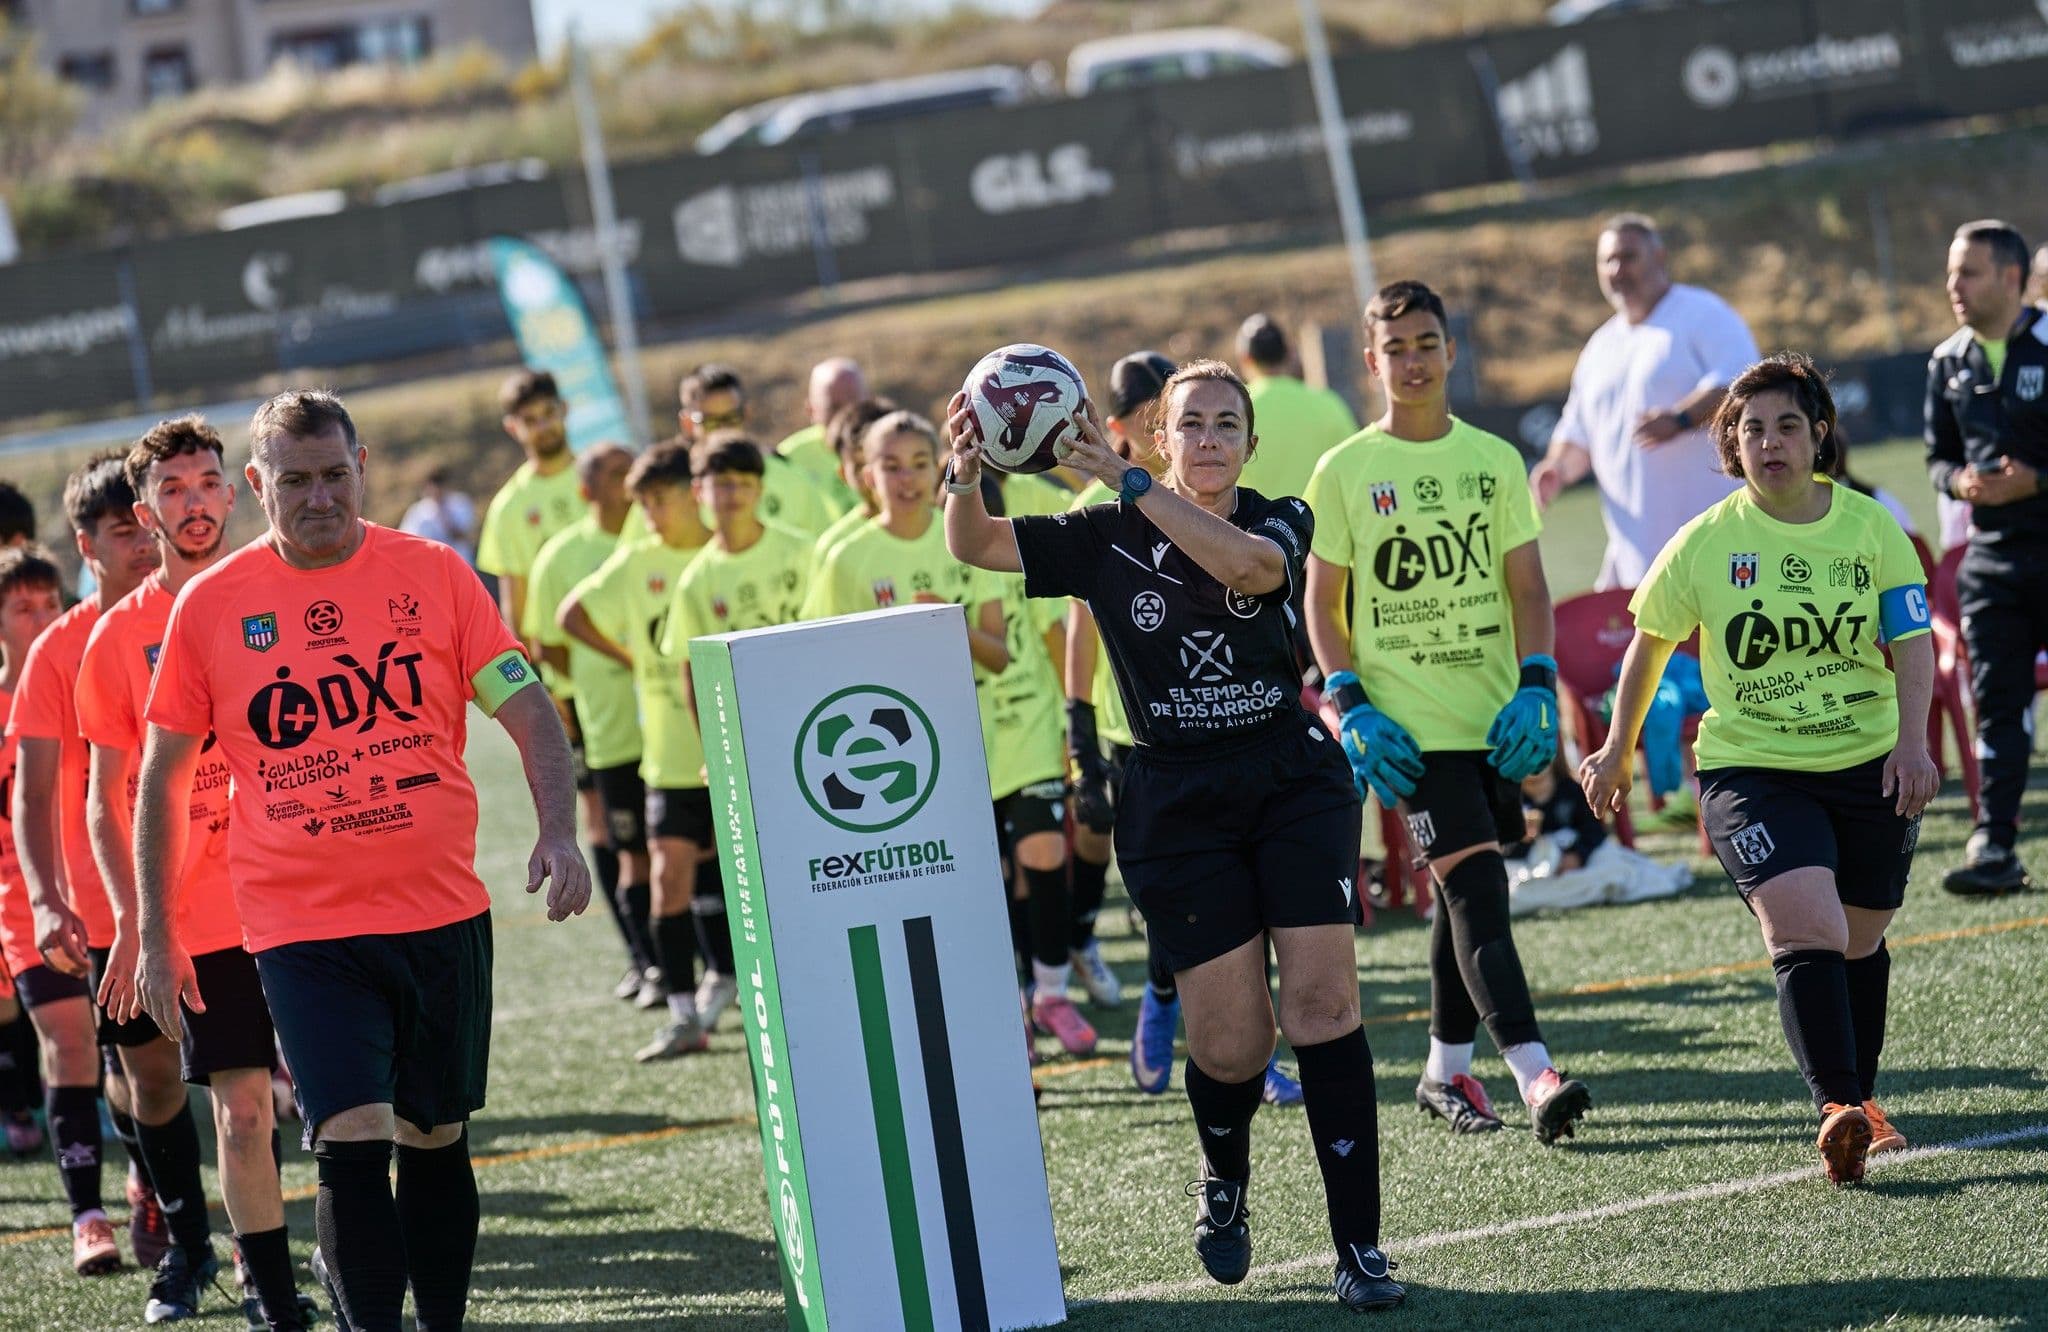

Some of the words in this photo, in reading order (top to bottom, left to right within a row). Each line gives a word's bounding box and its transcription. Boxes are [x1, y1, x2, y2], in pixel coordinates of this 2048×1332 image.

[1905, 588, 1927, 623] C
[1168, 688, 1192, 703] EL
[1191, 680, 1264, 702] TEMPLO
[1149, 702, 1173, 718] DE
[1176, 703, 1209, 718] LOS
[331, 810, 413, 833] EXTREMADURA
[358, 806, 393, 820] RURAL
[393, 802, 407, 812] DE
[811, 876, 862, 893] FEDERACIÓN
[864, 868, 911, 886] EXTREMEÑA
[912, 867, 923, 877] DE
[925, 863, 956, 876] FÚTBOL
